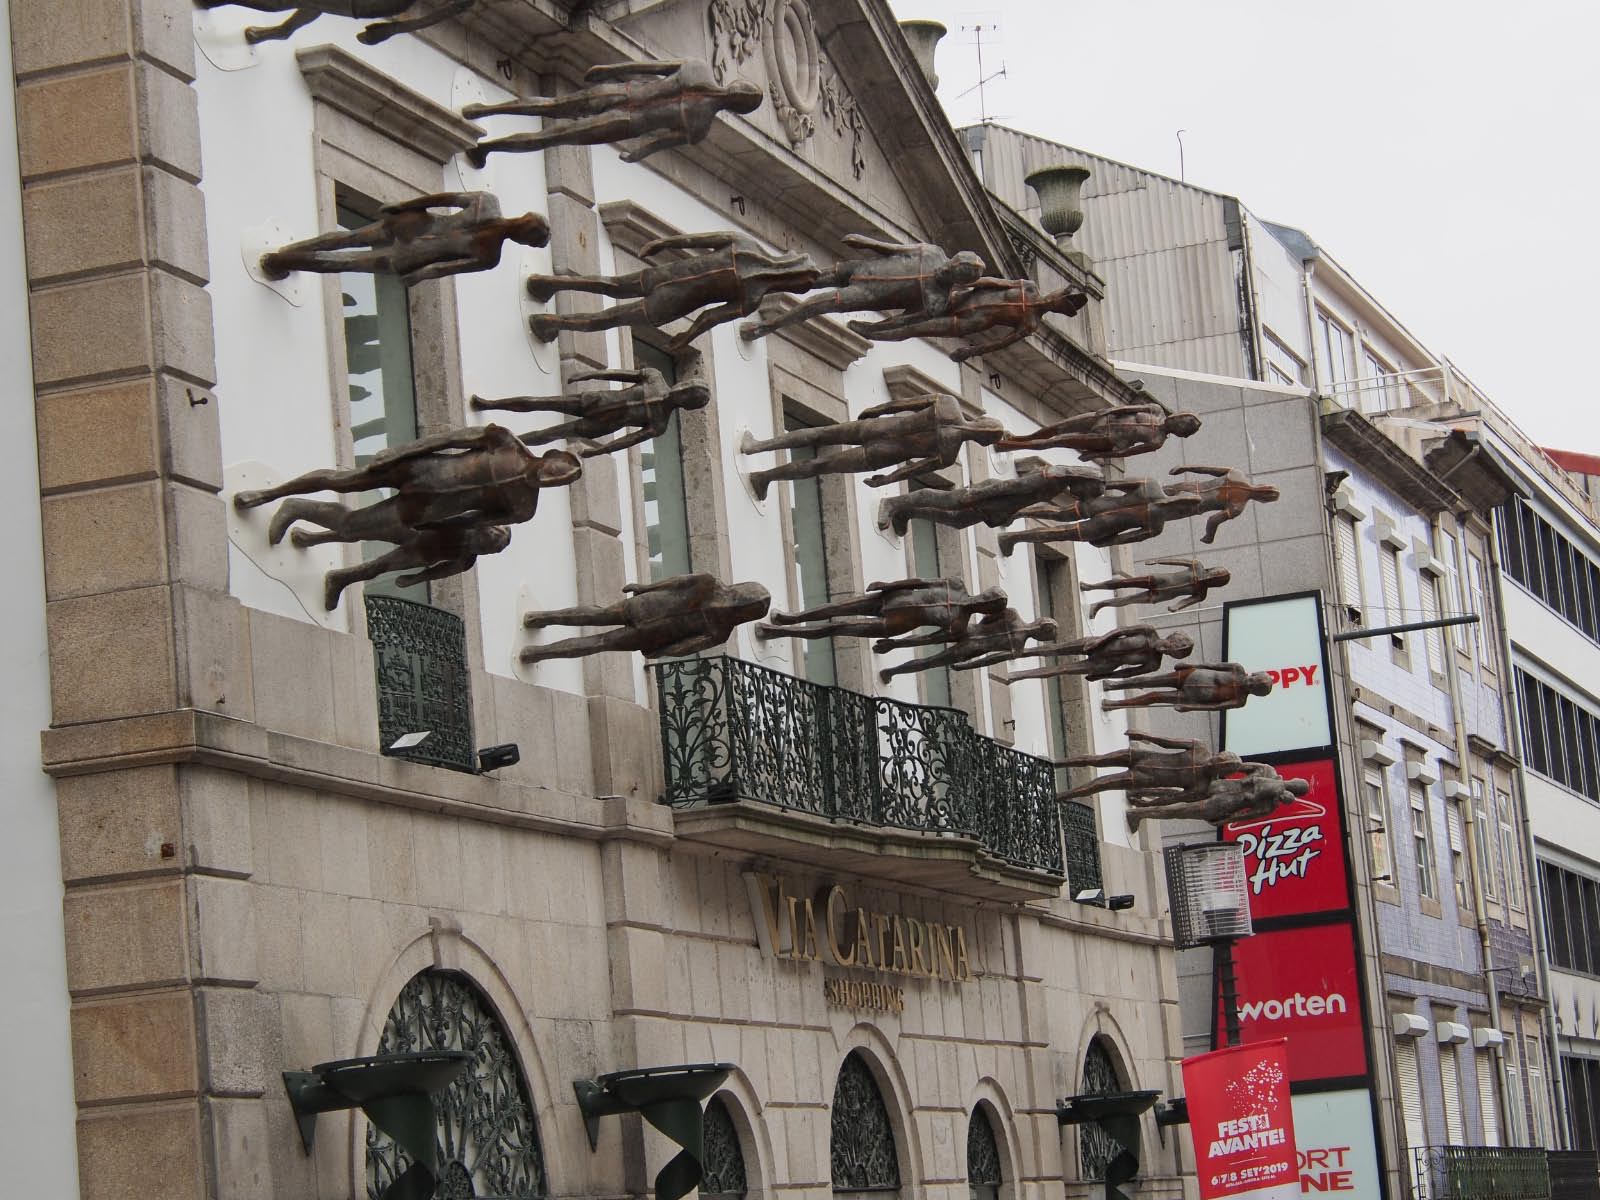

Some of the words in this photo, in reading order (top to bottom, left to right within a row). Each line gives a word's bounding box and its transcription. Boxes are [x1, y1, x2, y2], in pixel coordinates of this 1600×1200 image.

[1237, 825, 1323, 859] Pizza
[1249, 848, 1321, 895] Hut
[826, 884, 972, 982] CATARINA
[830, 976, 904, 1012] SHOPPING
[1236, 992, 1347, 1022] worten
[1208, 1127, 1286, 1159] AVANTE!
